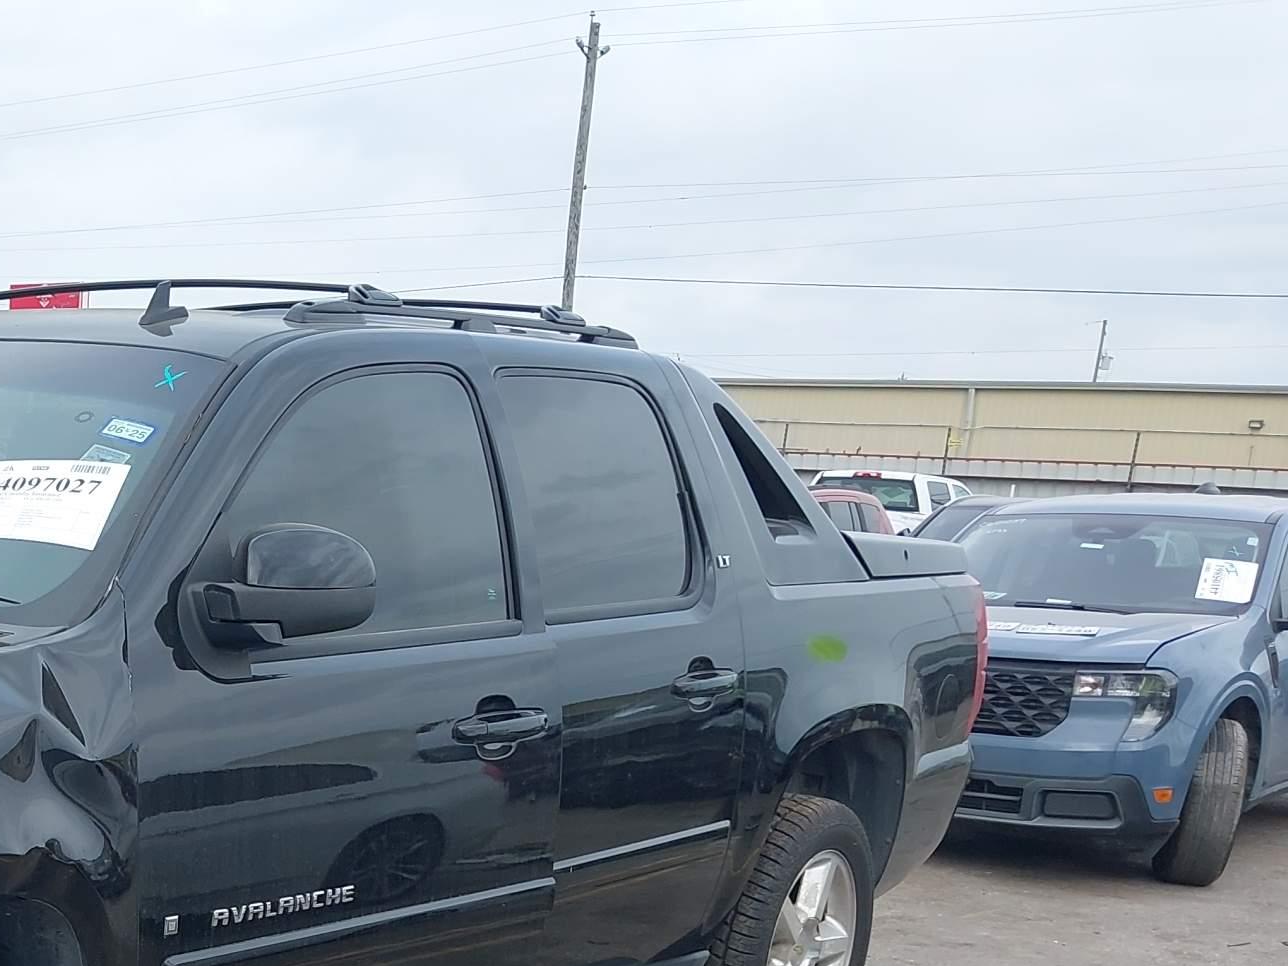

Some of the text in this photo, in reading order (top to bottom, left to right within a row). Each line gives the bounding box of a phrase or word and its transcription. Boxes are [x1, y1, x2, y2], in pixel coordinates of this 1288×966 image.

[107, 424, 148, 439] 06 25
[716, 554, 730, 568] LT
[212, 885, 355, 927] AVALANCHE
